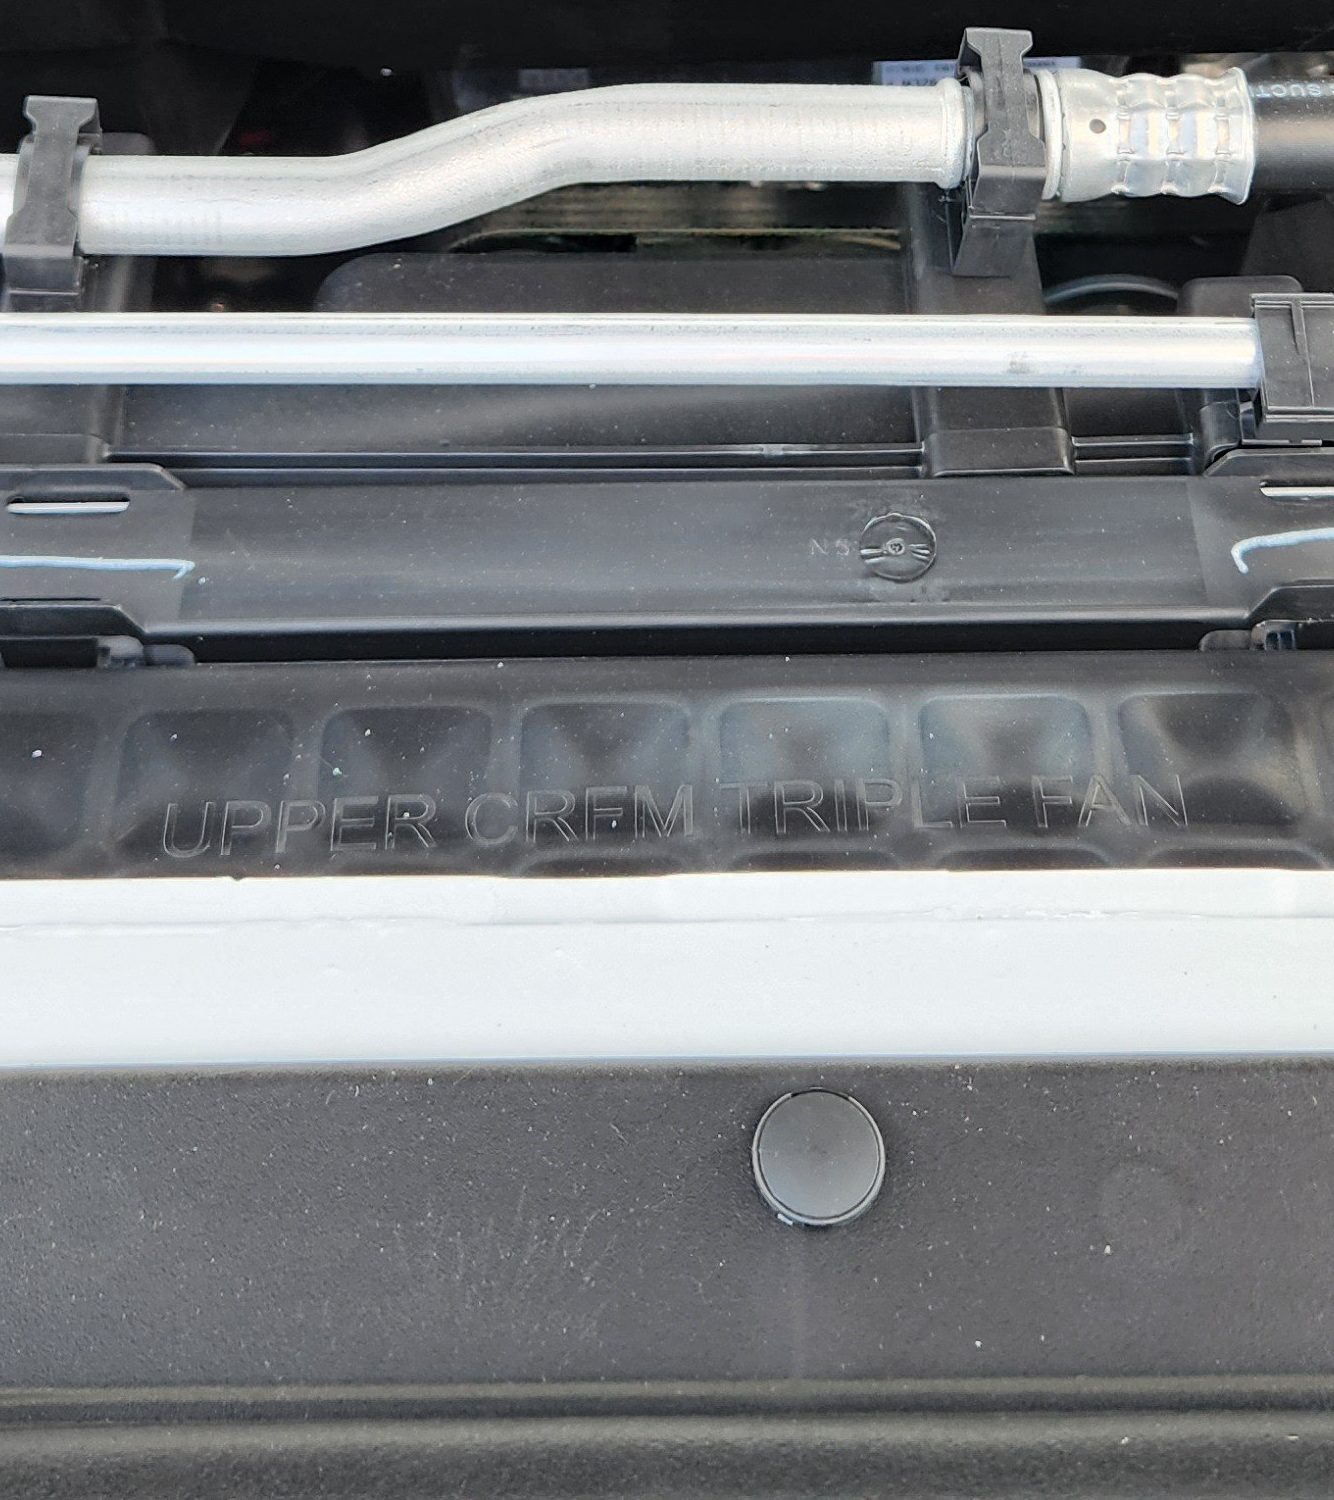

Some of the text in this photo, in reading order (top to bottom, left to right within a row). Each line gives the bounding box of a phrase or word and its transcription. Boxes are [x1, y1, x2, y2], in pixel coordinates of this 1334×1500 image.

[162, 773, 1189, 858] UPPER CRFM TRIPLE FAN
